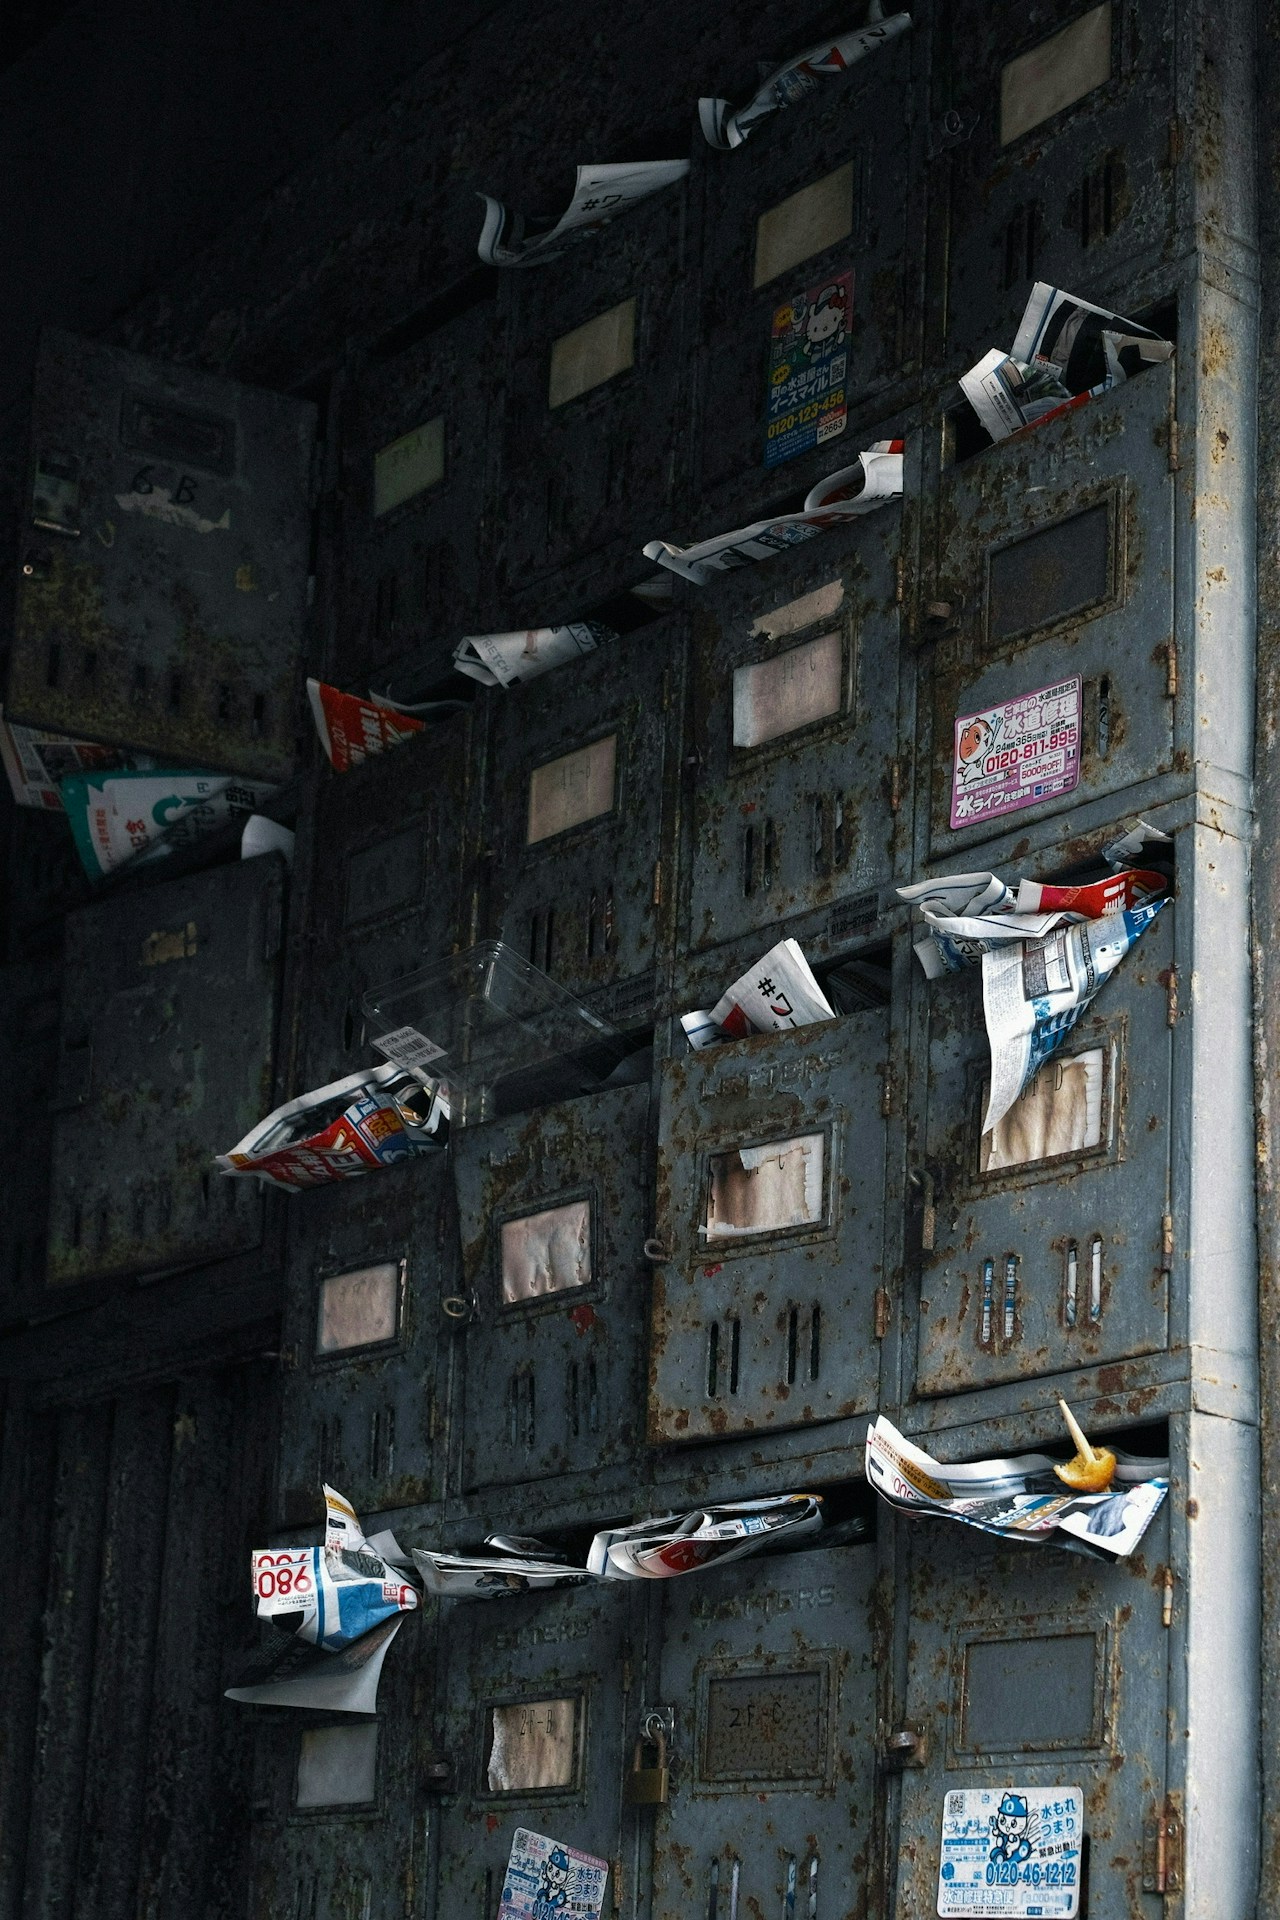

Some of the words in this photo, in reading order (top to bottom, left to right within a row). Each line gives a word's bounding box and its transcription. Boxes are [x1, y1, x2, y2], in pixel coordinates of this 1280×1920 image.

[770, 375, 829, 413] イースマイル
[824, 419, 843, 435] 2663
[1004, 690, 1078, 740] 水道修理
[986, 729, 1077, 773] 0120-811-995
[258, 1565, 312, 1599] 980
[1041, 1798, 1075, 1820] 水もれ
[1041, 1817, 1075, 1837] つまり
[576, 1866, 602, 1882] 水もれ
[986, 1862, 1077, 1886] 0120-46-1212
[574, 1882, 600, 1898] つまり
